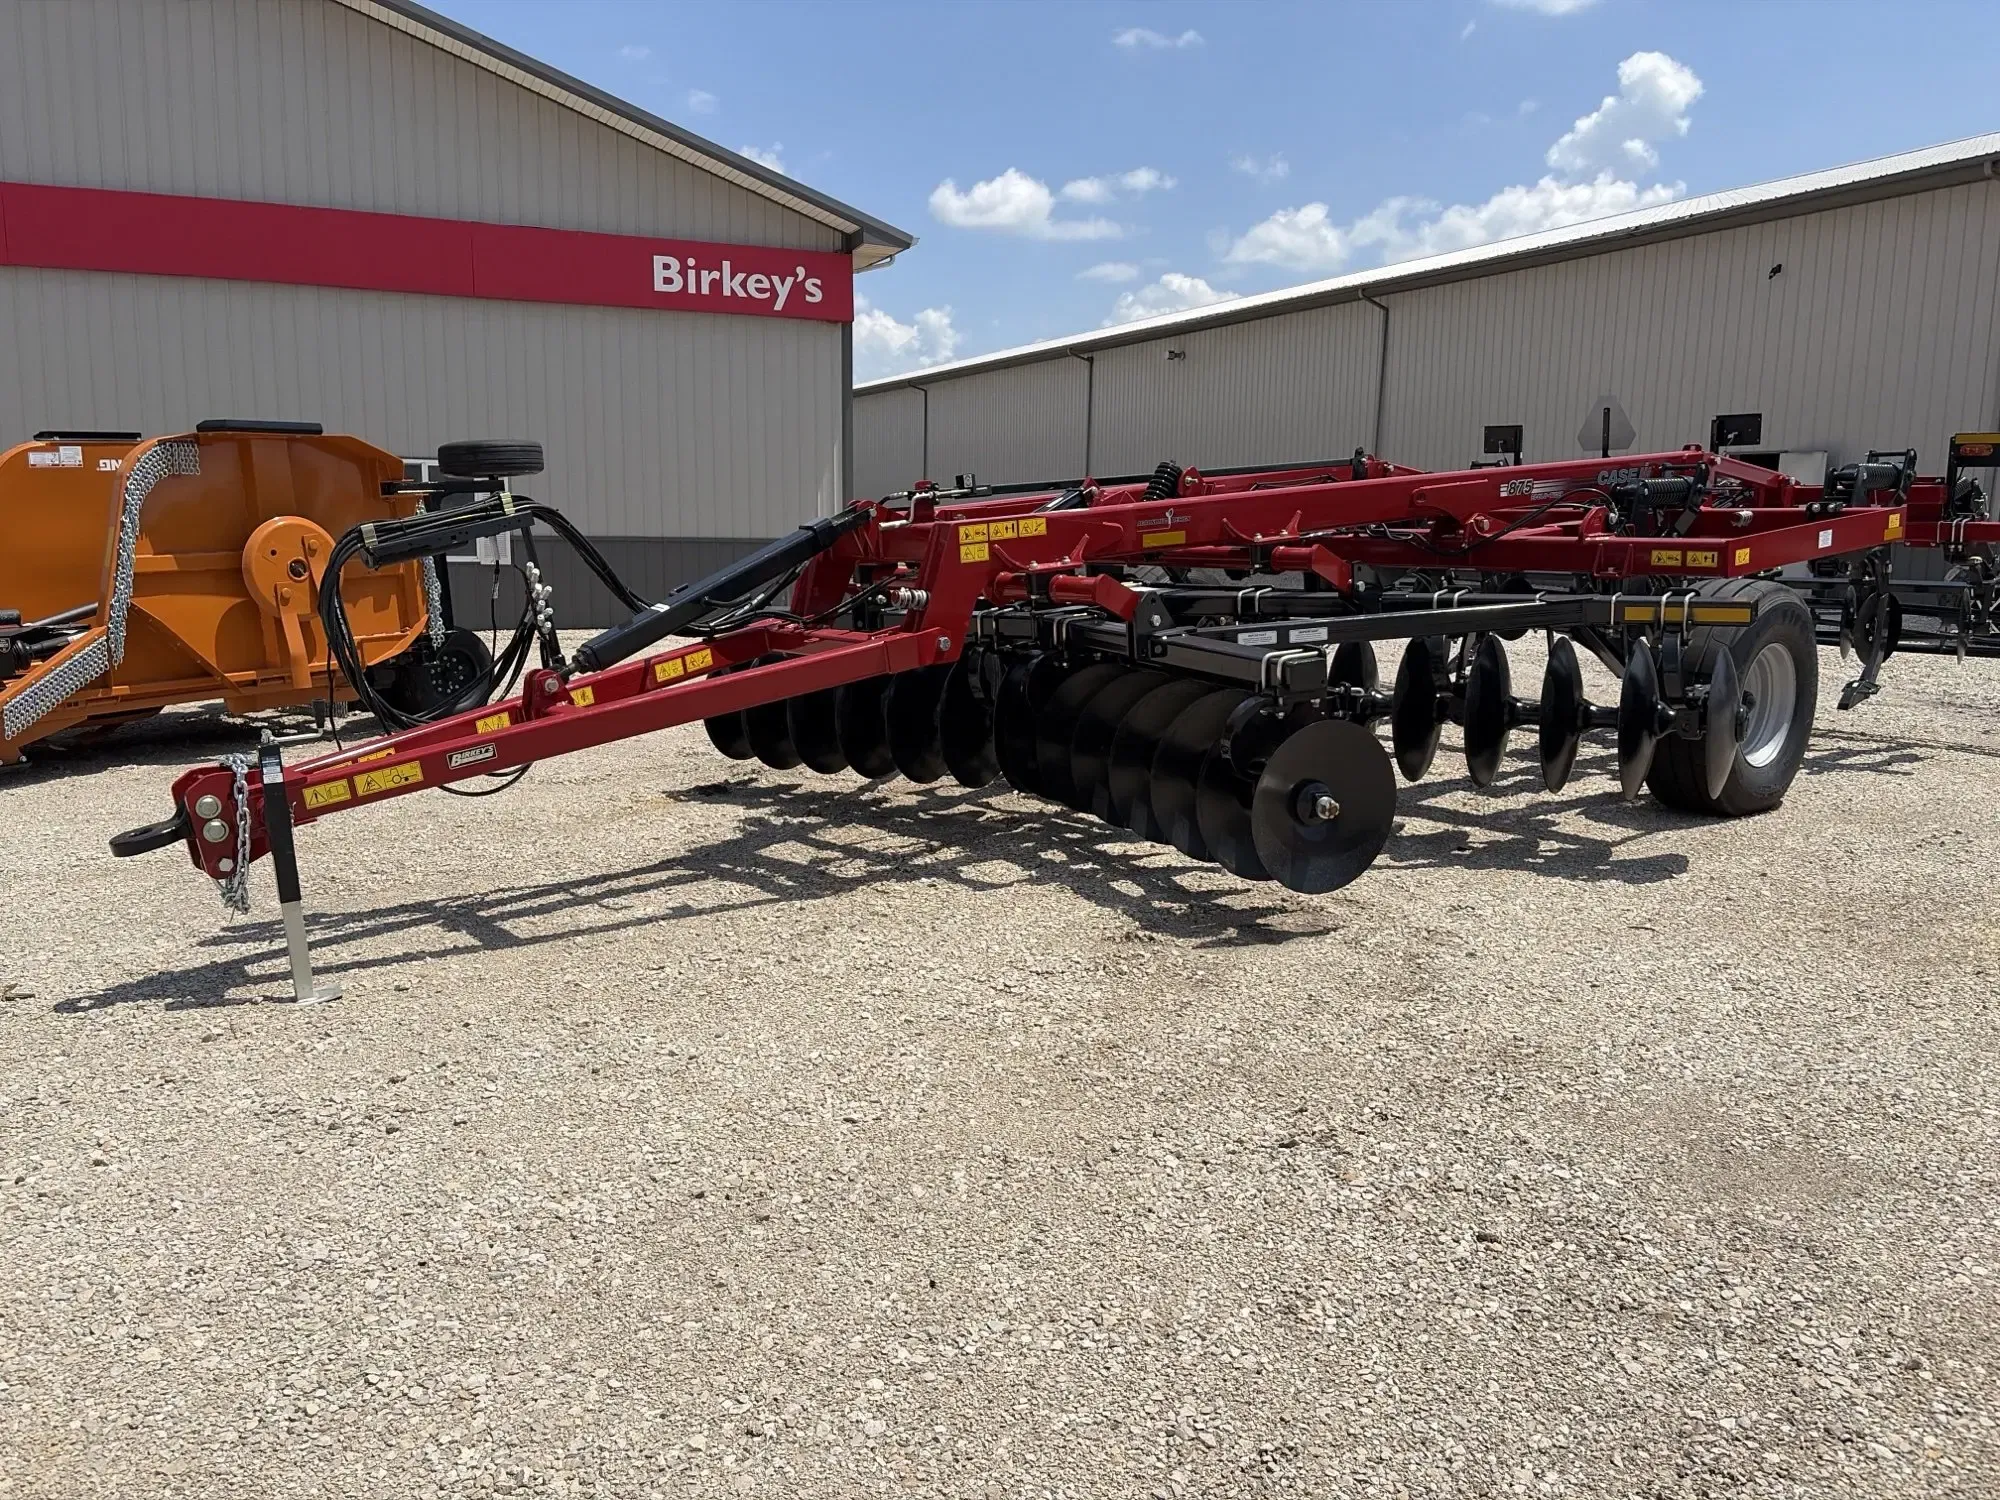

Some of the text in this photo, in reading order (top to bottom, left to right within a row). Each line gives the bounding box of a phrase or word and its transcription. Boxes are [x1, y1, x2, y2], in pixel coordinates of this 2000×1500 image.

[653, 255, 824, 311] Birkey's
[1597, 468, 1638, 486] CASE
[1507, 479, 1533, 496] 875
[450, 745, 494, 767] BIRKEY'S
